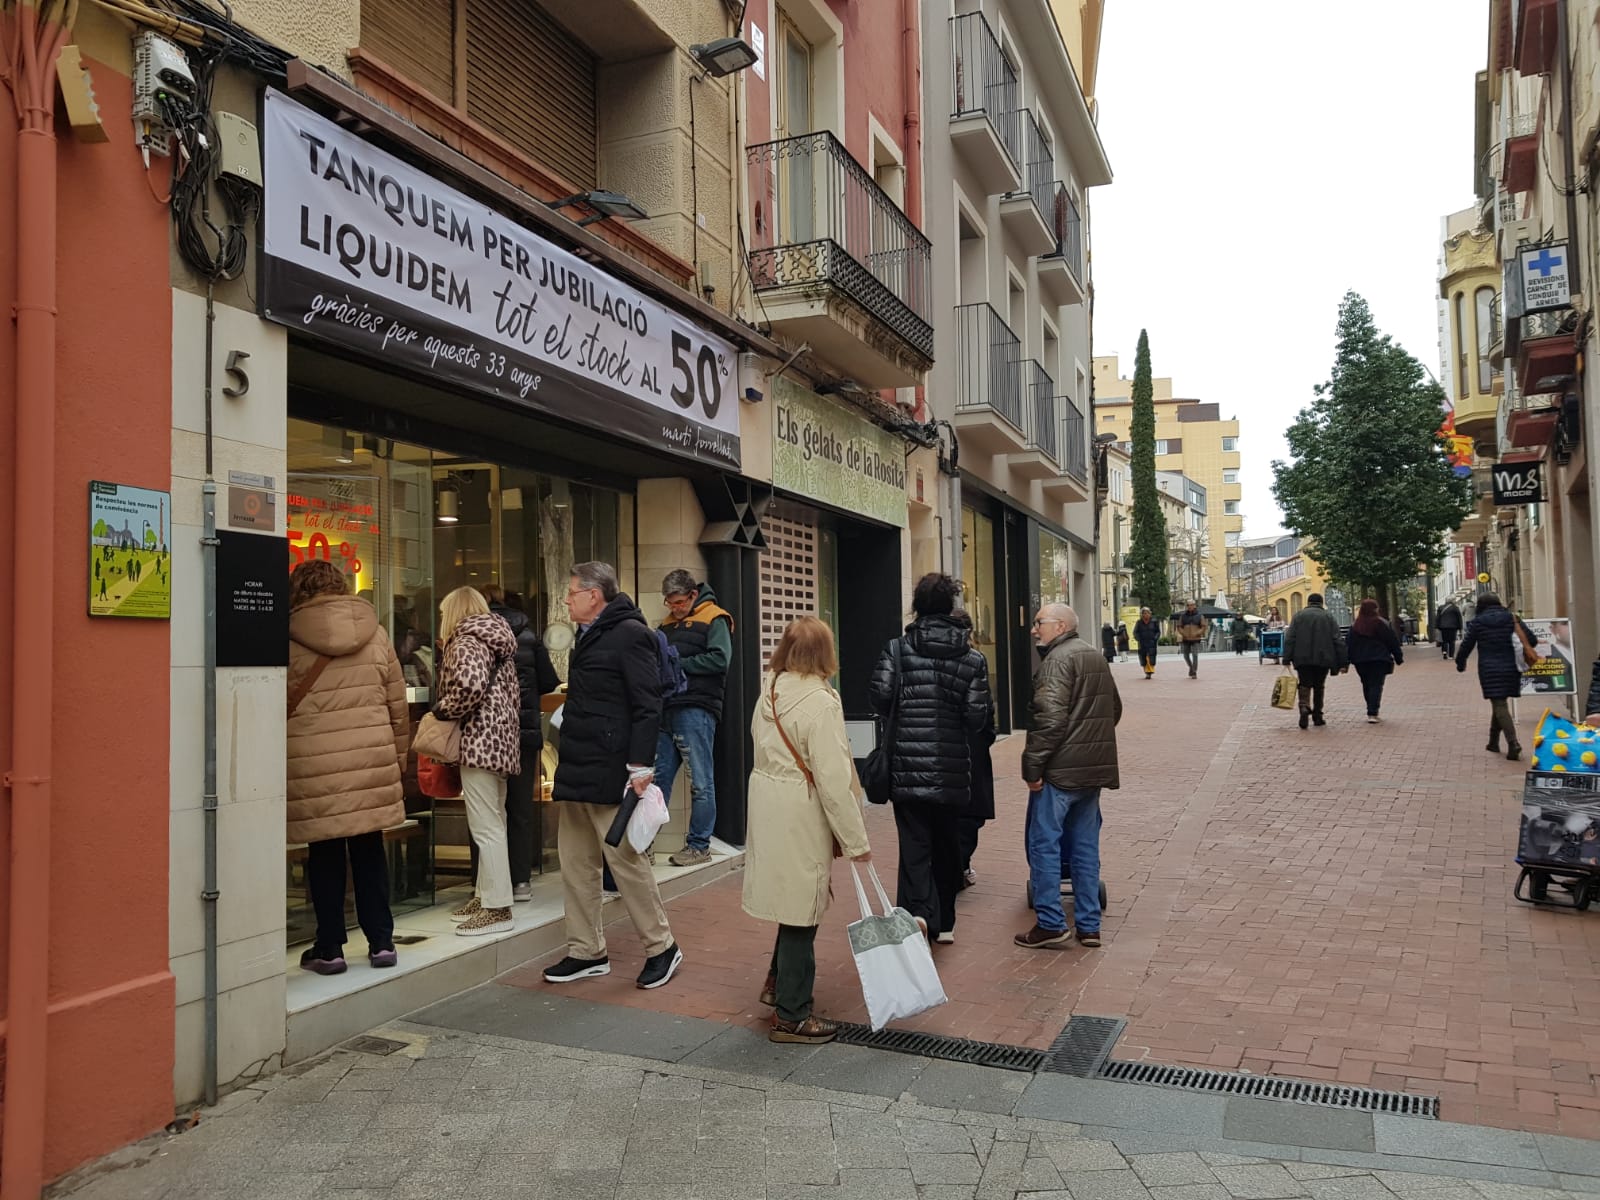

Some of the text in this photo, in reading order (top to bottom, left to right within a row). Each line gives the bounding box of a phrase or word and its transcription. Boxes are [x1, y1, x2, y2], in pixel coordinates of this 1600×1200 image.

[300, 129, 648, 338] TANQUEM PER JUBILACIÓ
[1527, 281, 1568, 293] CARNET DE
[1528, 275, 1565, 285] REVISIONS
[1528, 290, 1559, 301] CONDUIR
[300, 204, 472, 314] LIQUIDEM
[493, 280, 537, 345] tot
[543, 313, 573, 361] el
[576, 322, 634, 386] stock
[640, 363, 662, 396] AL
[1535, 297, 1560, 307] ARMES
[303, 293, 542, 398] gràcies per aquests 33 anys
[223, 350, 250, 398] 5
[777, 404, 905, 491] Els gelats de la Rosita
[95, 495, 127, 506] Respecteu
[137, 502, 158, 510] normes
